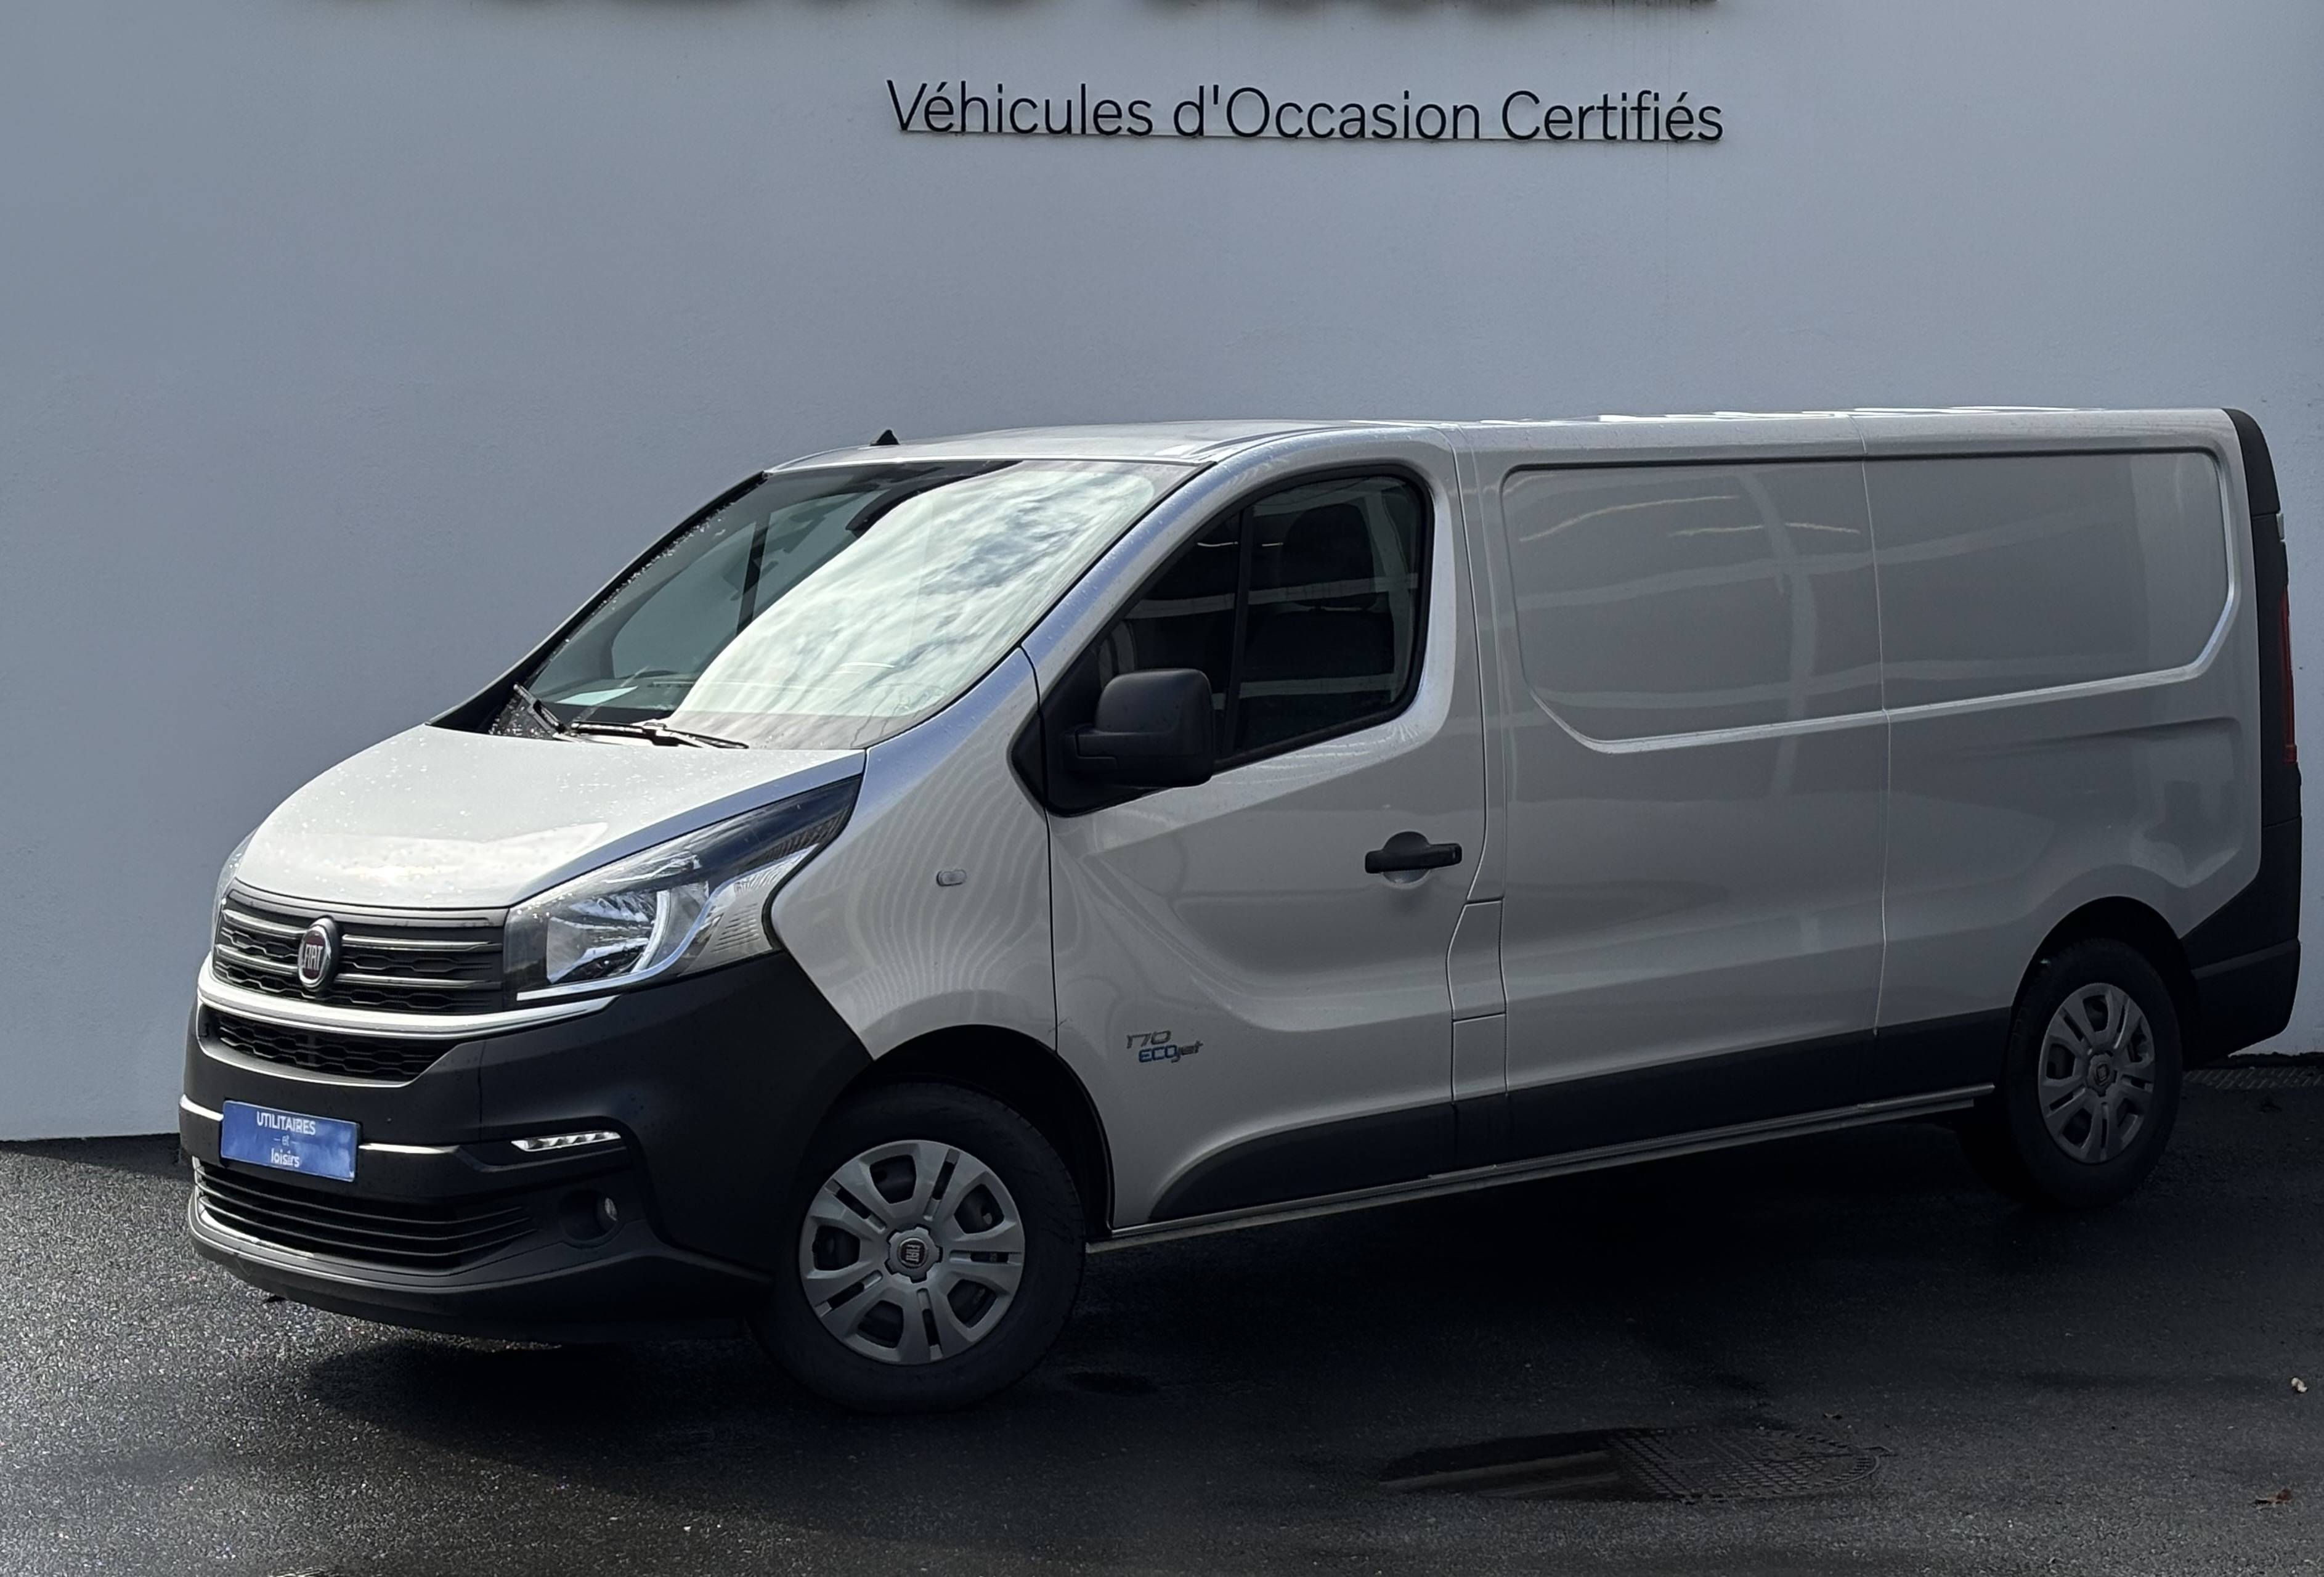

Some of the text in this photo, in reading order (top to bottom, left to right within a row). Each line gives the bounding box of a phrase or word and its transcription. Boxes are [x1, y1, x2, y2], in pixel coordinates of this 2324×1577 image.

[886, 79, 1724, 141] Véhicules d'Occasion Certifiés
[304, 943, 324, 971] FIAT
[1126, 1030, 1171, 1049] 170
[256, 1111, 316, 1135] UTILITAIRES
[270, 1148, 300, 1168] loisirs
[906, 1244, 920, 1263] FIAT
